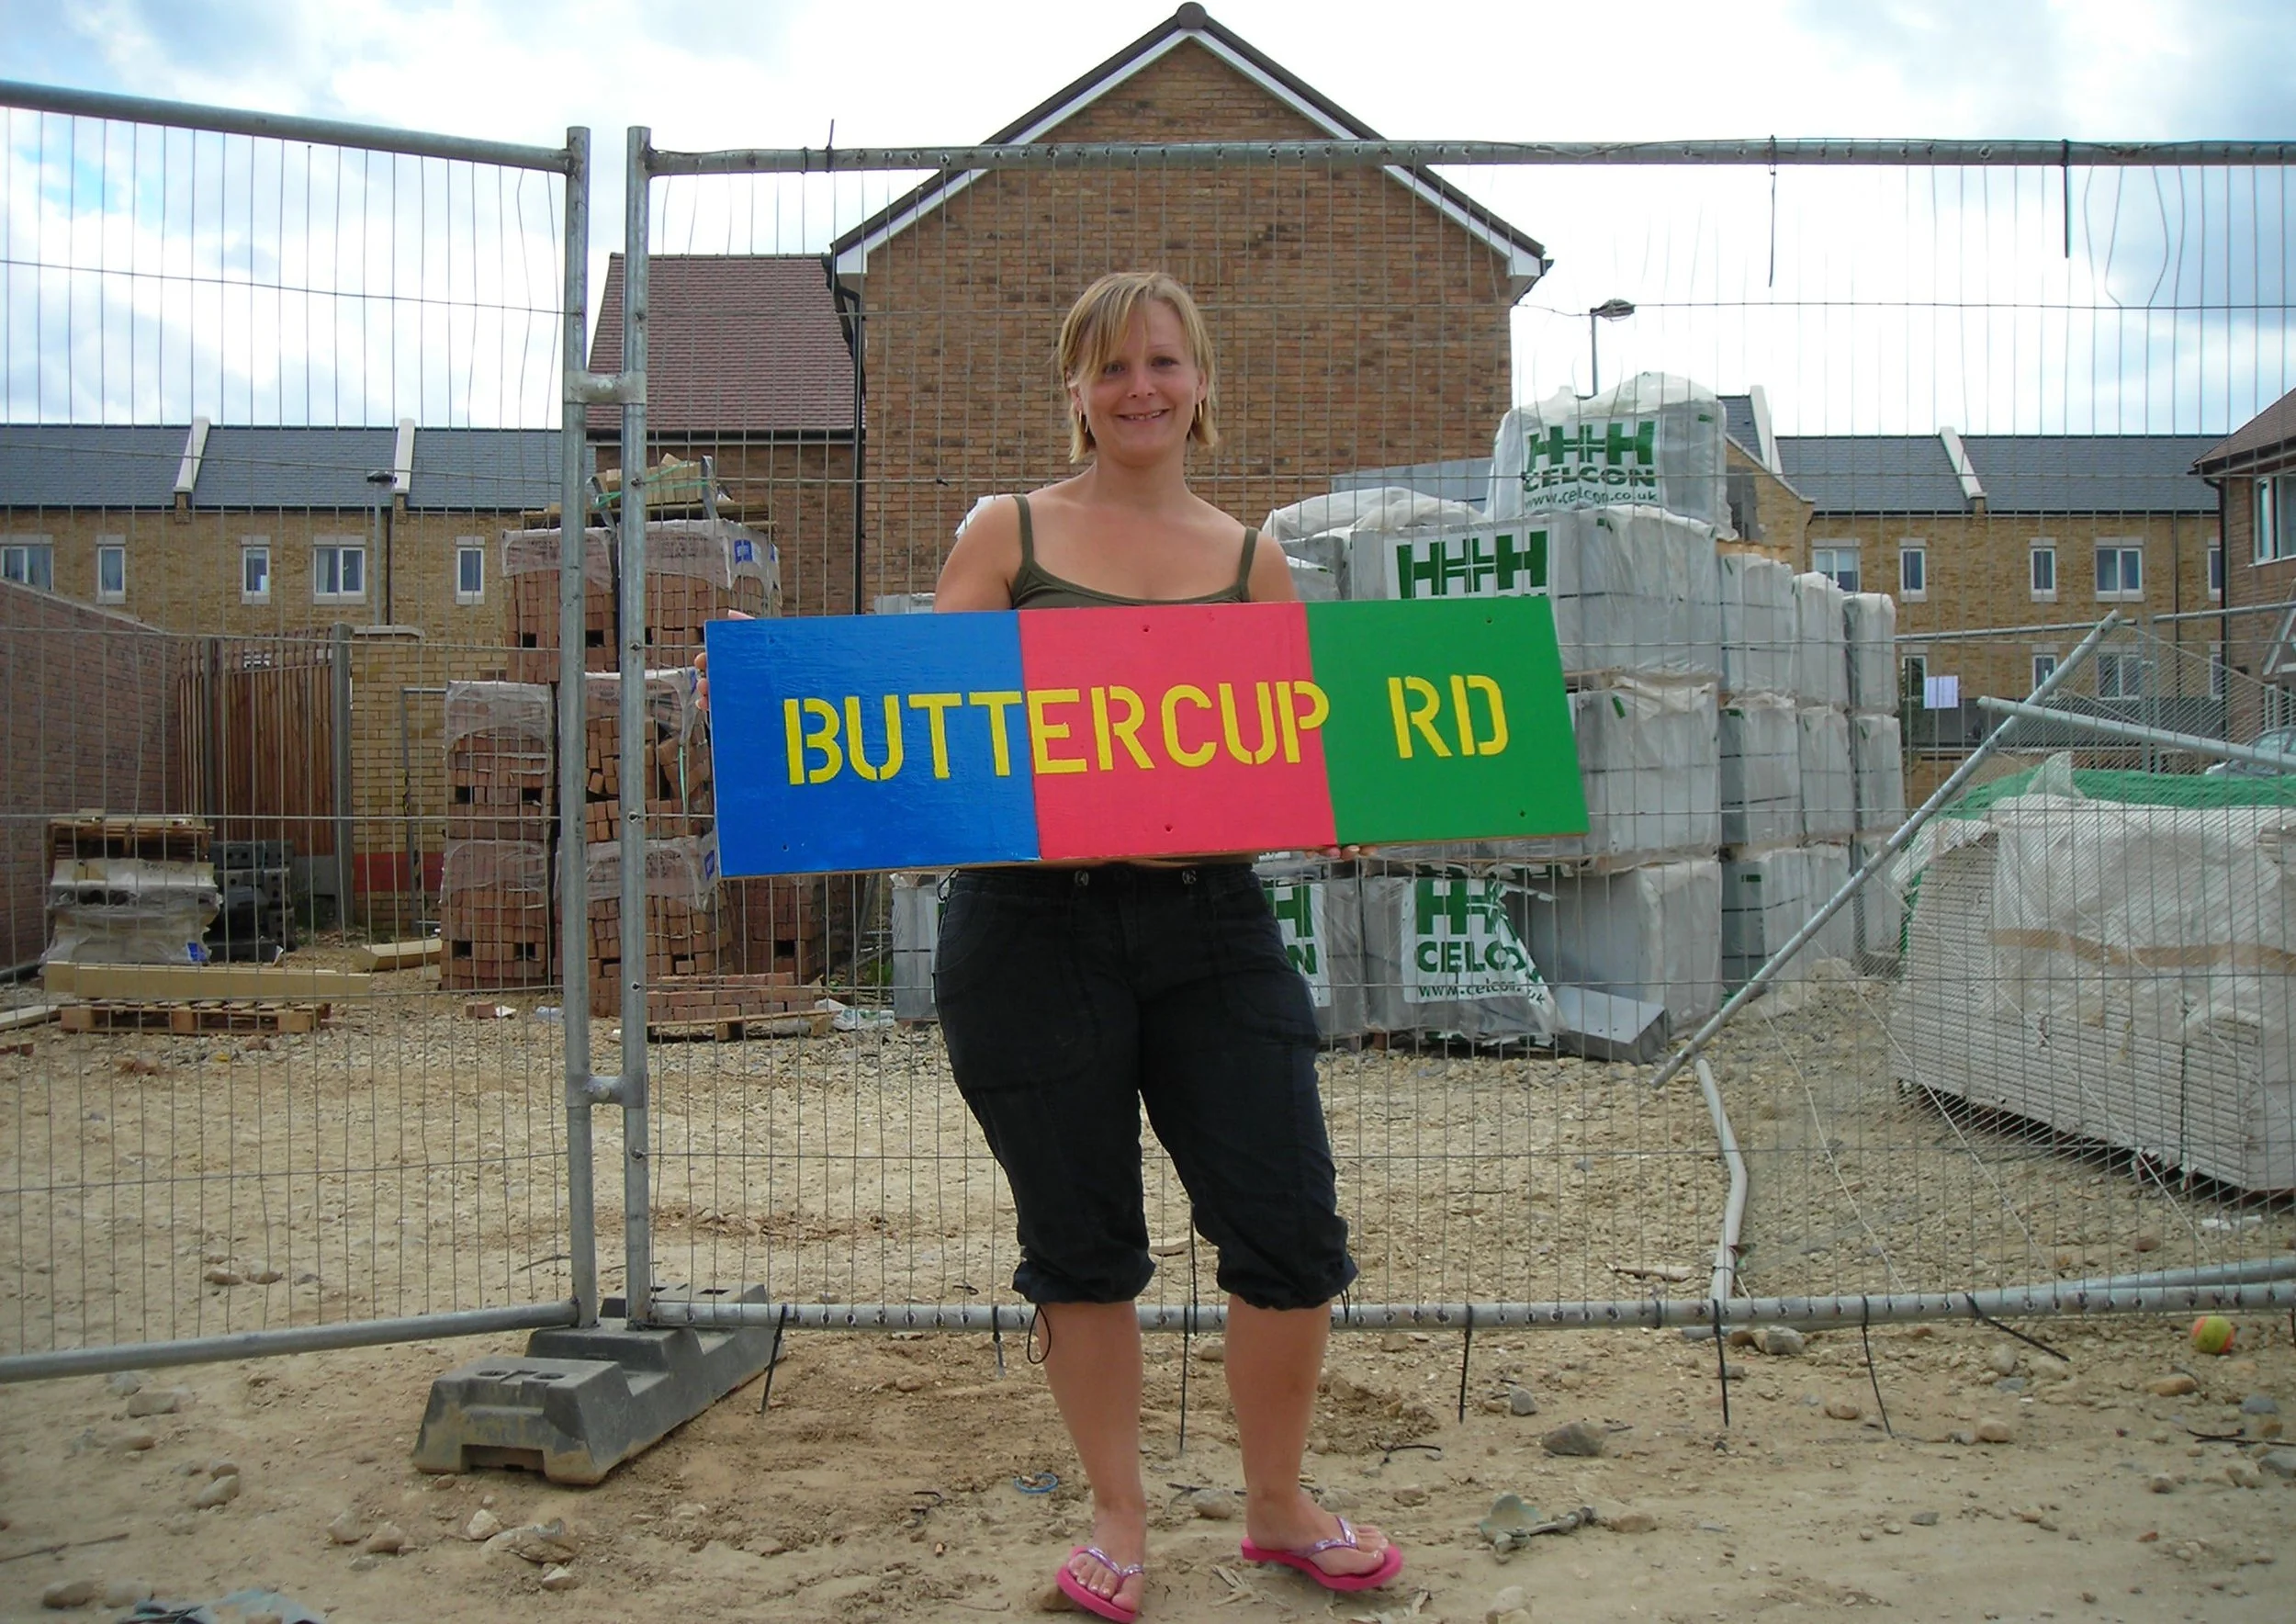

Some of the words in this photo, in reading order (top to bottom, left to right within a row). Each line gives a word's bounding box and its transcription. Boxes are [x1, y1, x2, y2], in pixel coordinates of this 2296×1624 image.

[1523, 466, 1656, 492] CELCON
[1524, 487, 1658, 509] www.celcon.co.uk
[783, 680, 1330, 785] BUTTERCUP
[1388, 674, 1510, 759] RD
